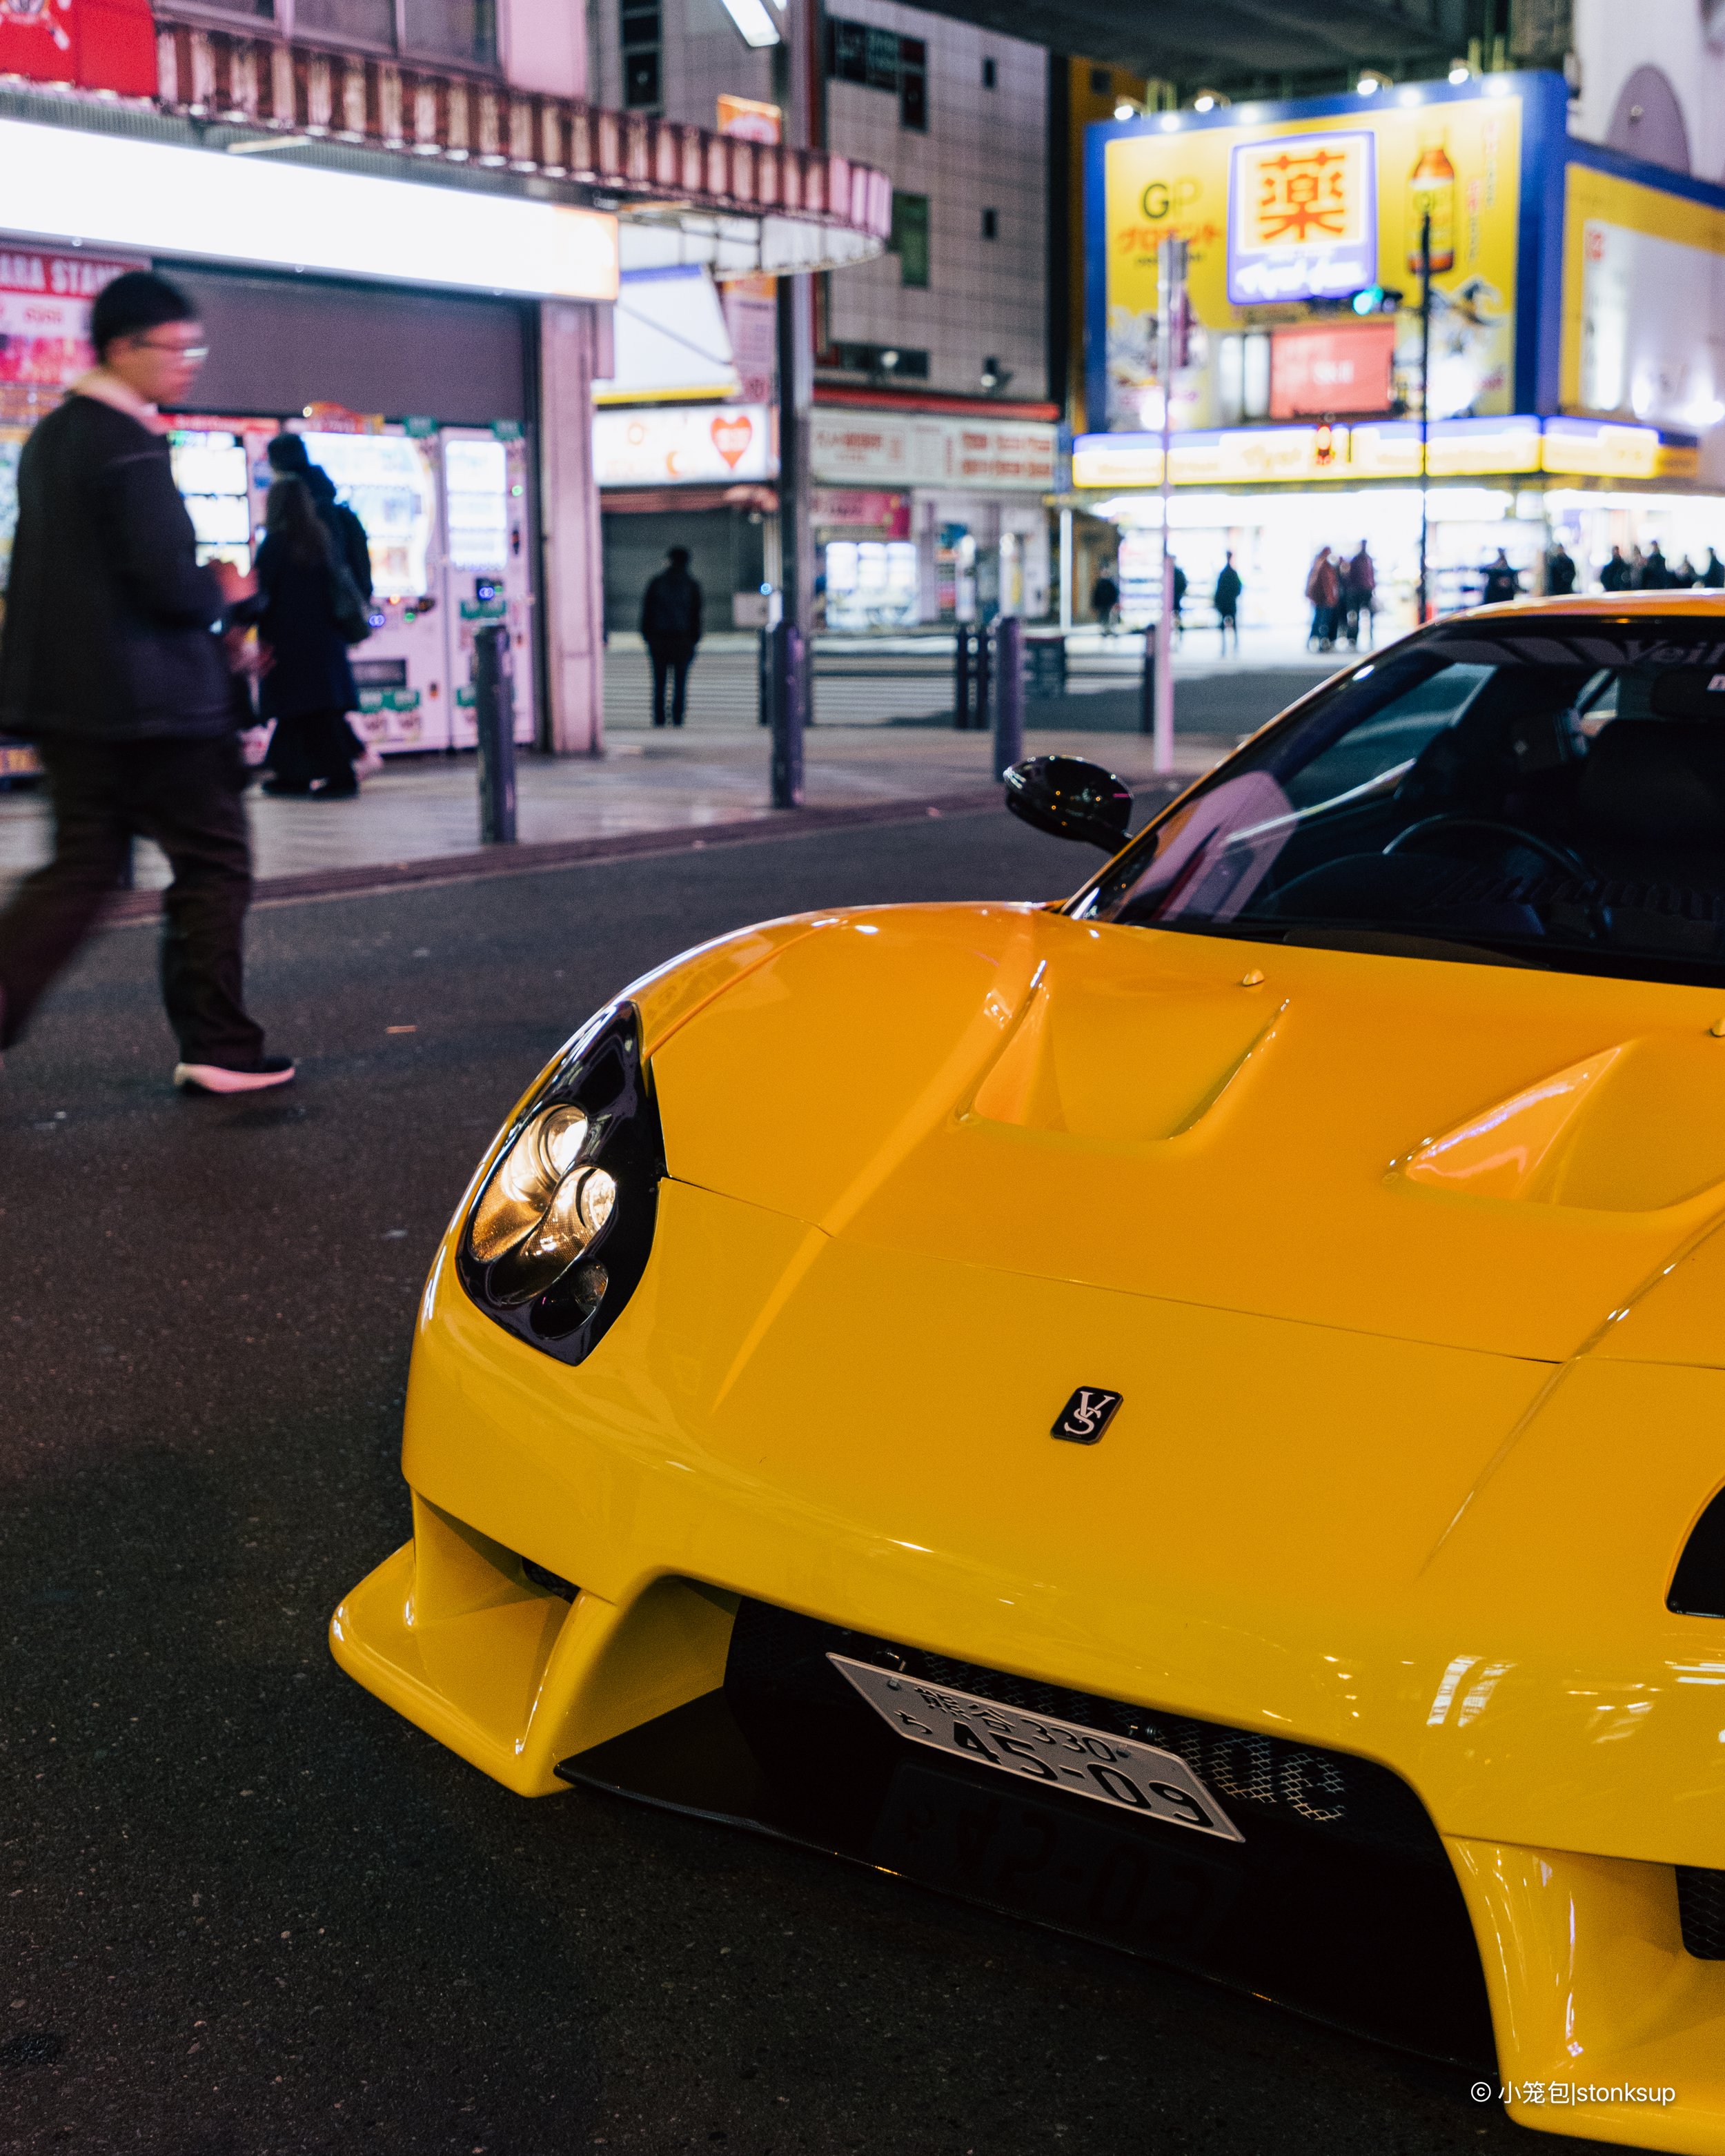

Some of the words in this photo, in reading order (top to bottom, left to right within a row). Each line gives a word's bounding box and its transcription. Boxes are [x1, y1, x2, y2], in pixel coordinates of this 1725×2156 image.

[1143, 177, 1203, 219] GP
[1260, 151, 1345, 239] 薬
[914, 1687, 1016, 1732] 熊谷
[1021, 1718, 1118, 1762] 330
[953, 1720, 1214, 1828] 45-09
